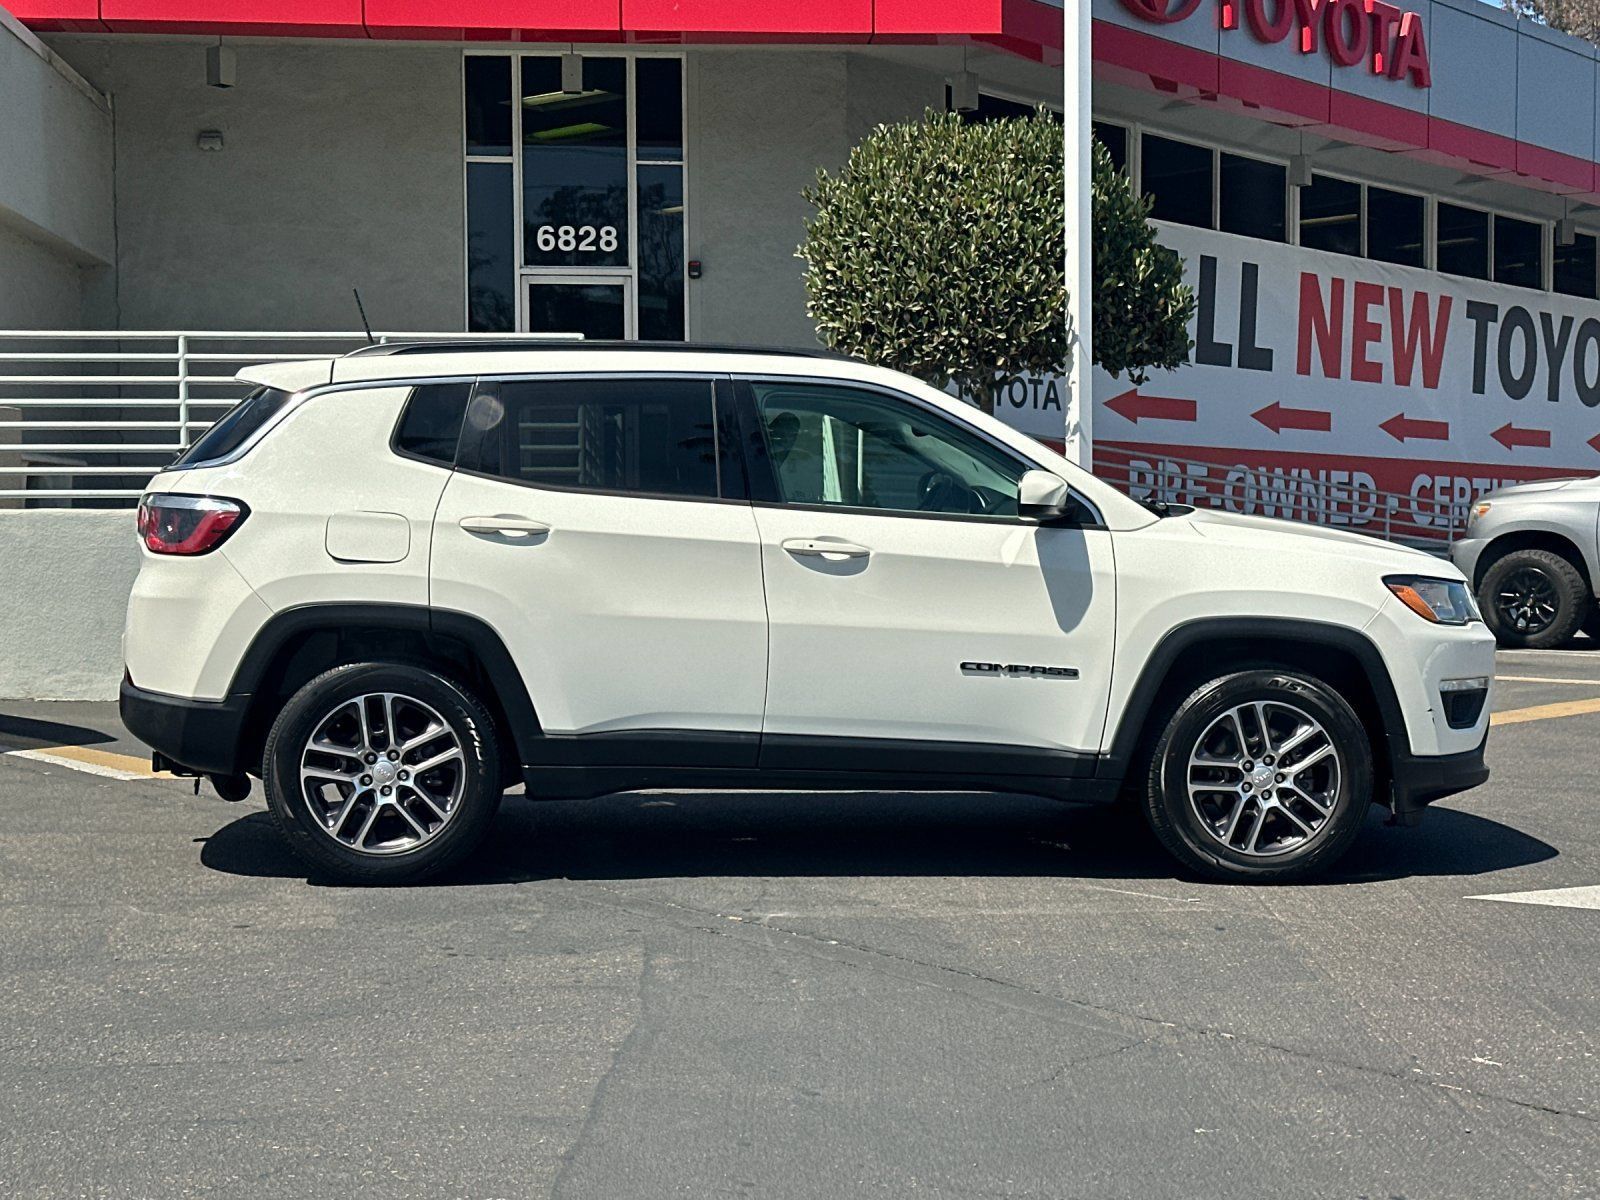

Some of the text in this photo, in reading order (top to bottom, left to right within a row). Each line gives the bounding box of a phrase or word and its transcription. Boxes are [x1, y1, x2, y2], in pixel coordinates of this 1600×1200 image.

[536, 225, 618, 252] 6828
[1158, 244, 1274, 372] LL
[1296, 272, 1453, 389] NEW
[1129, 459, 1377, 525] PRE-OWNED
[960, 661, 1079, 676] COMPASS
